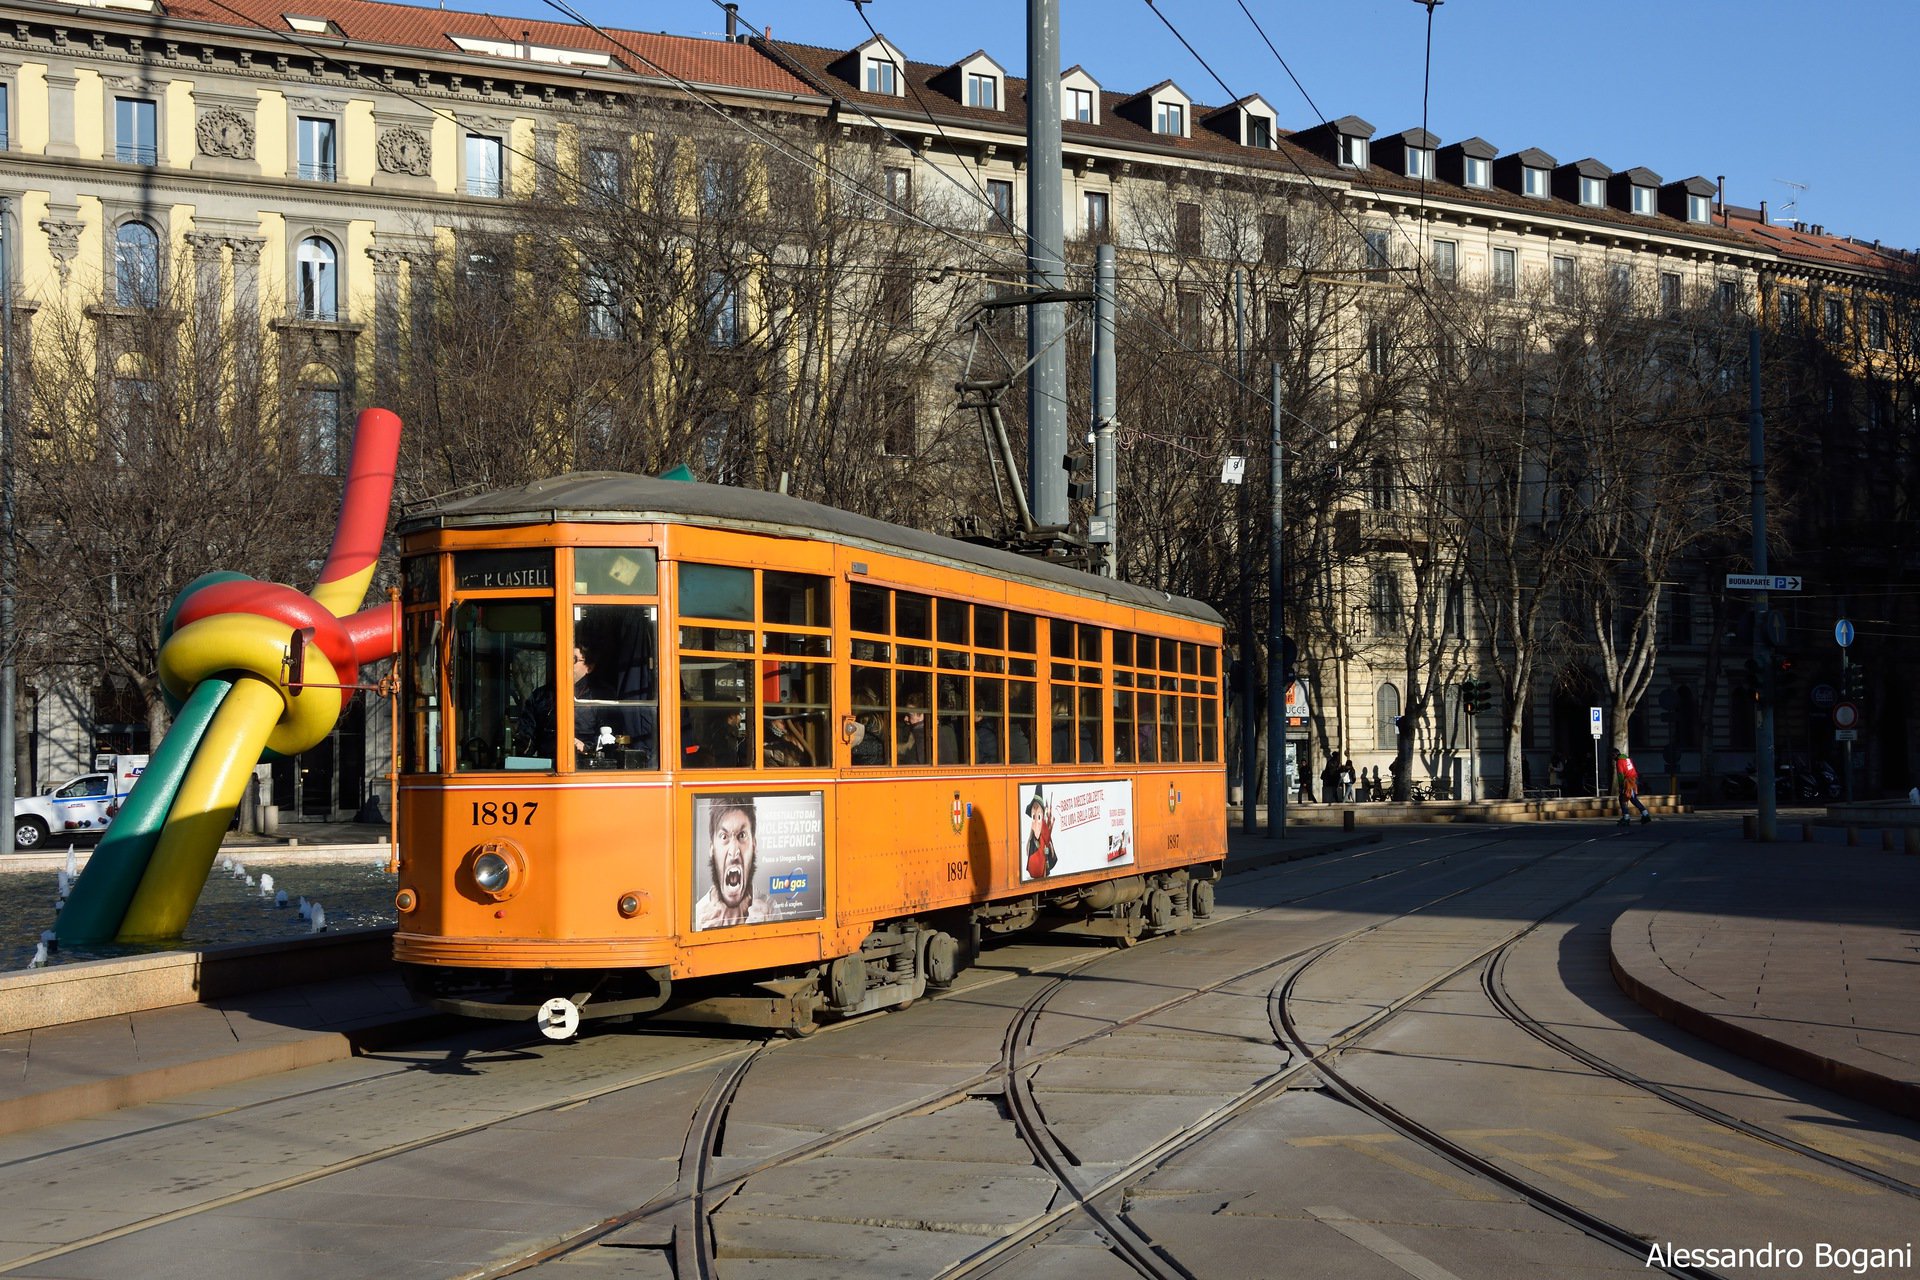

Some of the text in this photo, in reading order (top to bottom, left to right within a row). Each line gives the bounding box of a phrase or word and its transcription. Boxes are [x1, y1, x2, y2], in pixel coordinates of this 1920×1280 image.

[1729, 578, 1770, 586] BUONAPARTE
[472, 801, 539, 826] 1897
[758, 820, 820, 835] MOLESTATORI
[761, 834, 817, 849] TELEFONICI.
[1167, 834, 1179, 850] 1897
[947, 861, 968, 882] 1897
